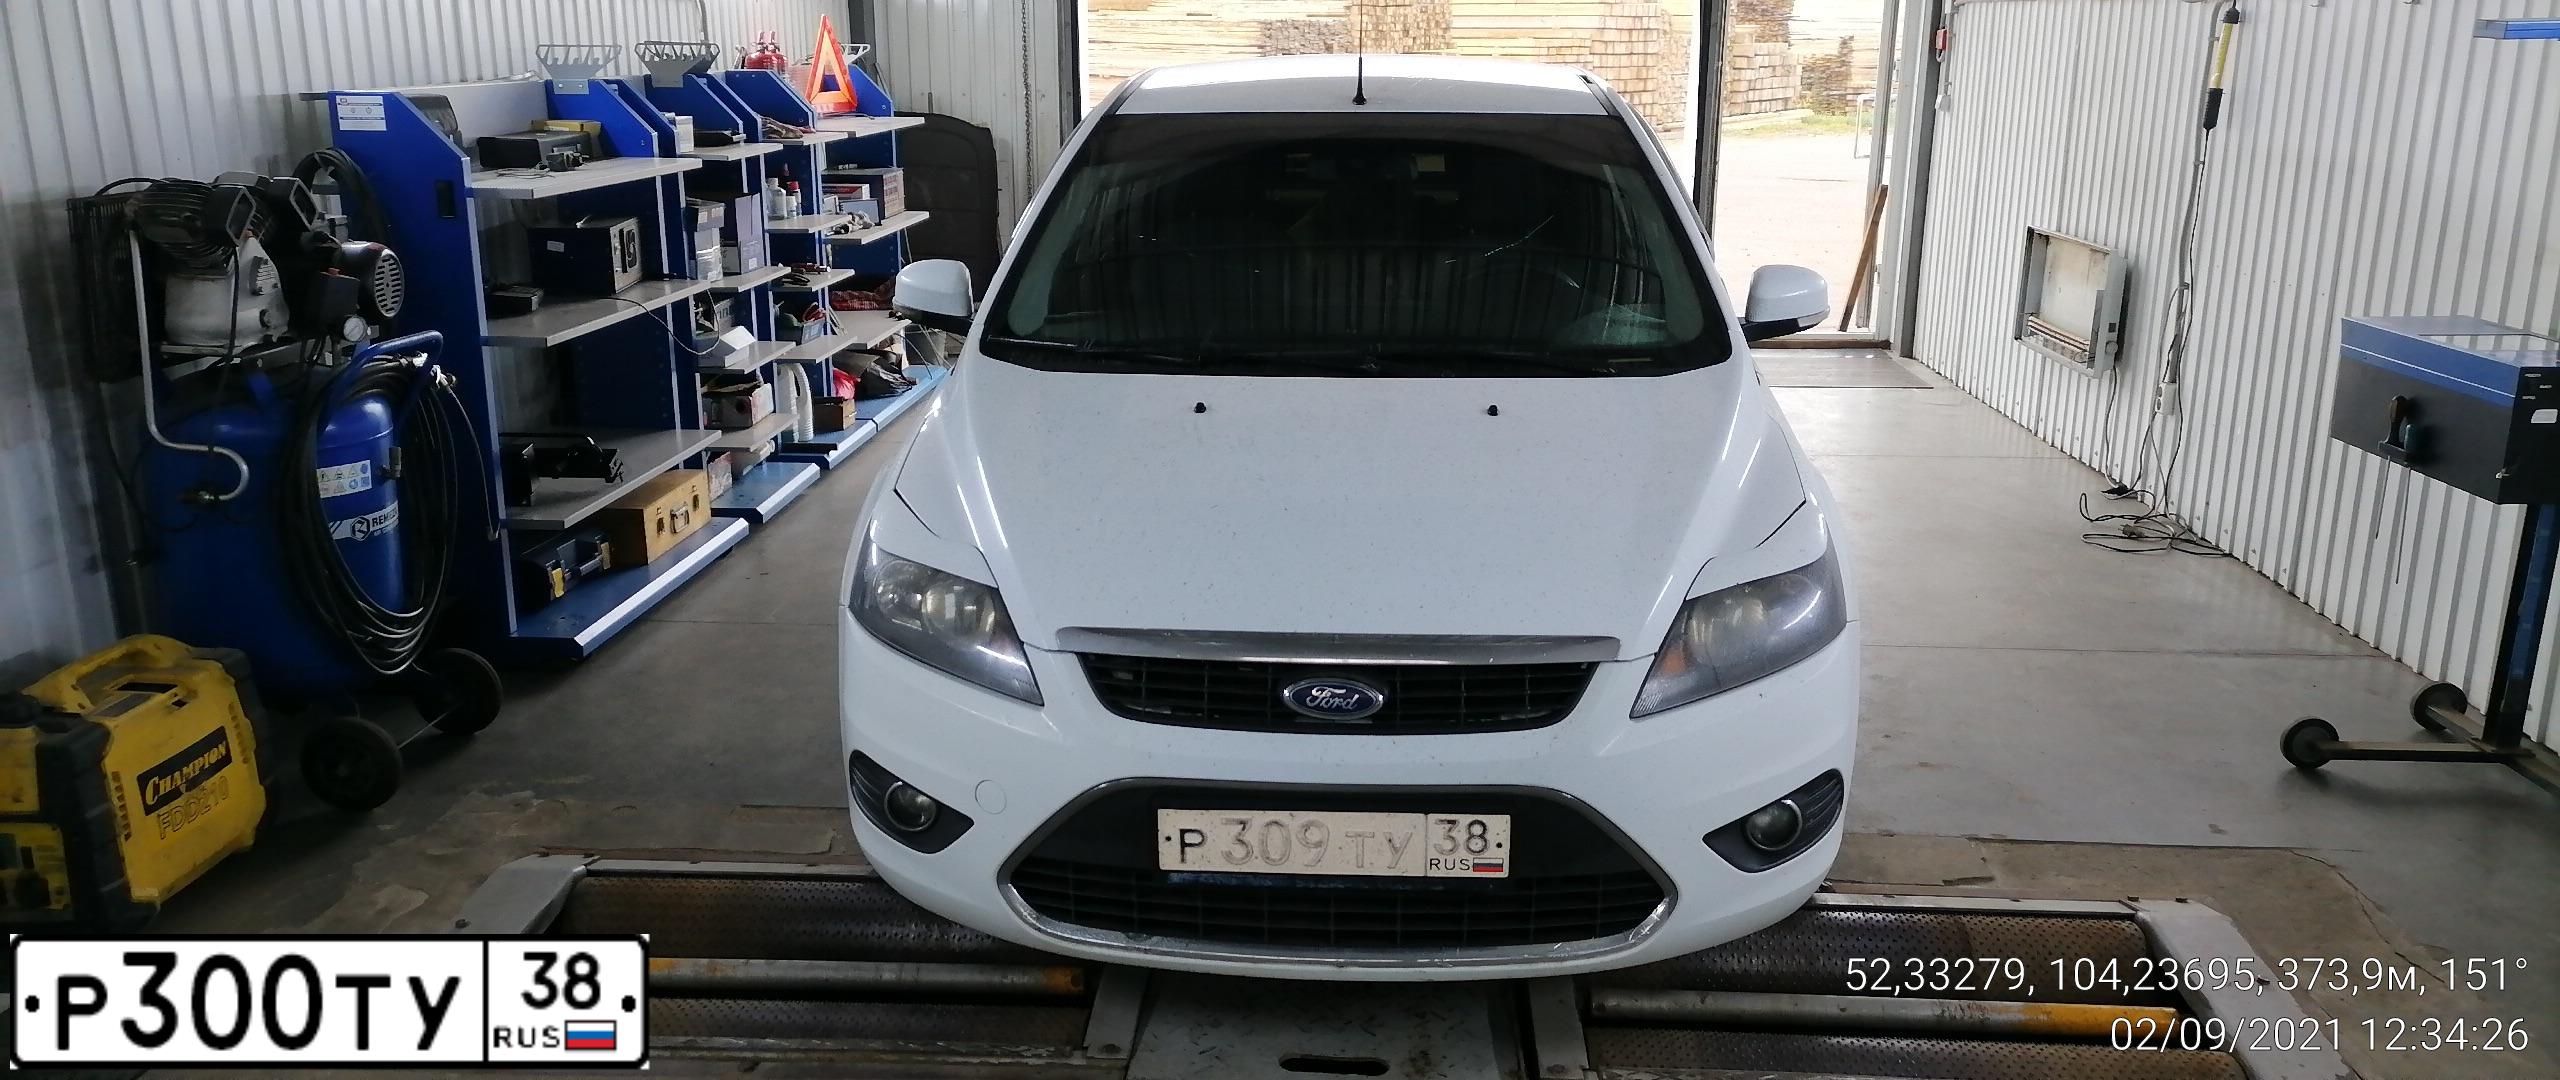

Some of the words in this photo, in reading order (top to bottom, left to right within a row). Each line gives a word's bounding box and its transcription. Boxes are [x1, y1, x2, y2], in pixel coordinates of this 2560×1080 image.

[1305, 686, 1360, 710] Ford
[1433, 818, 1490, 856] 38
[1429, 857, 1471, 872] RUS
